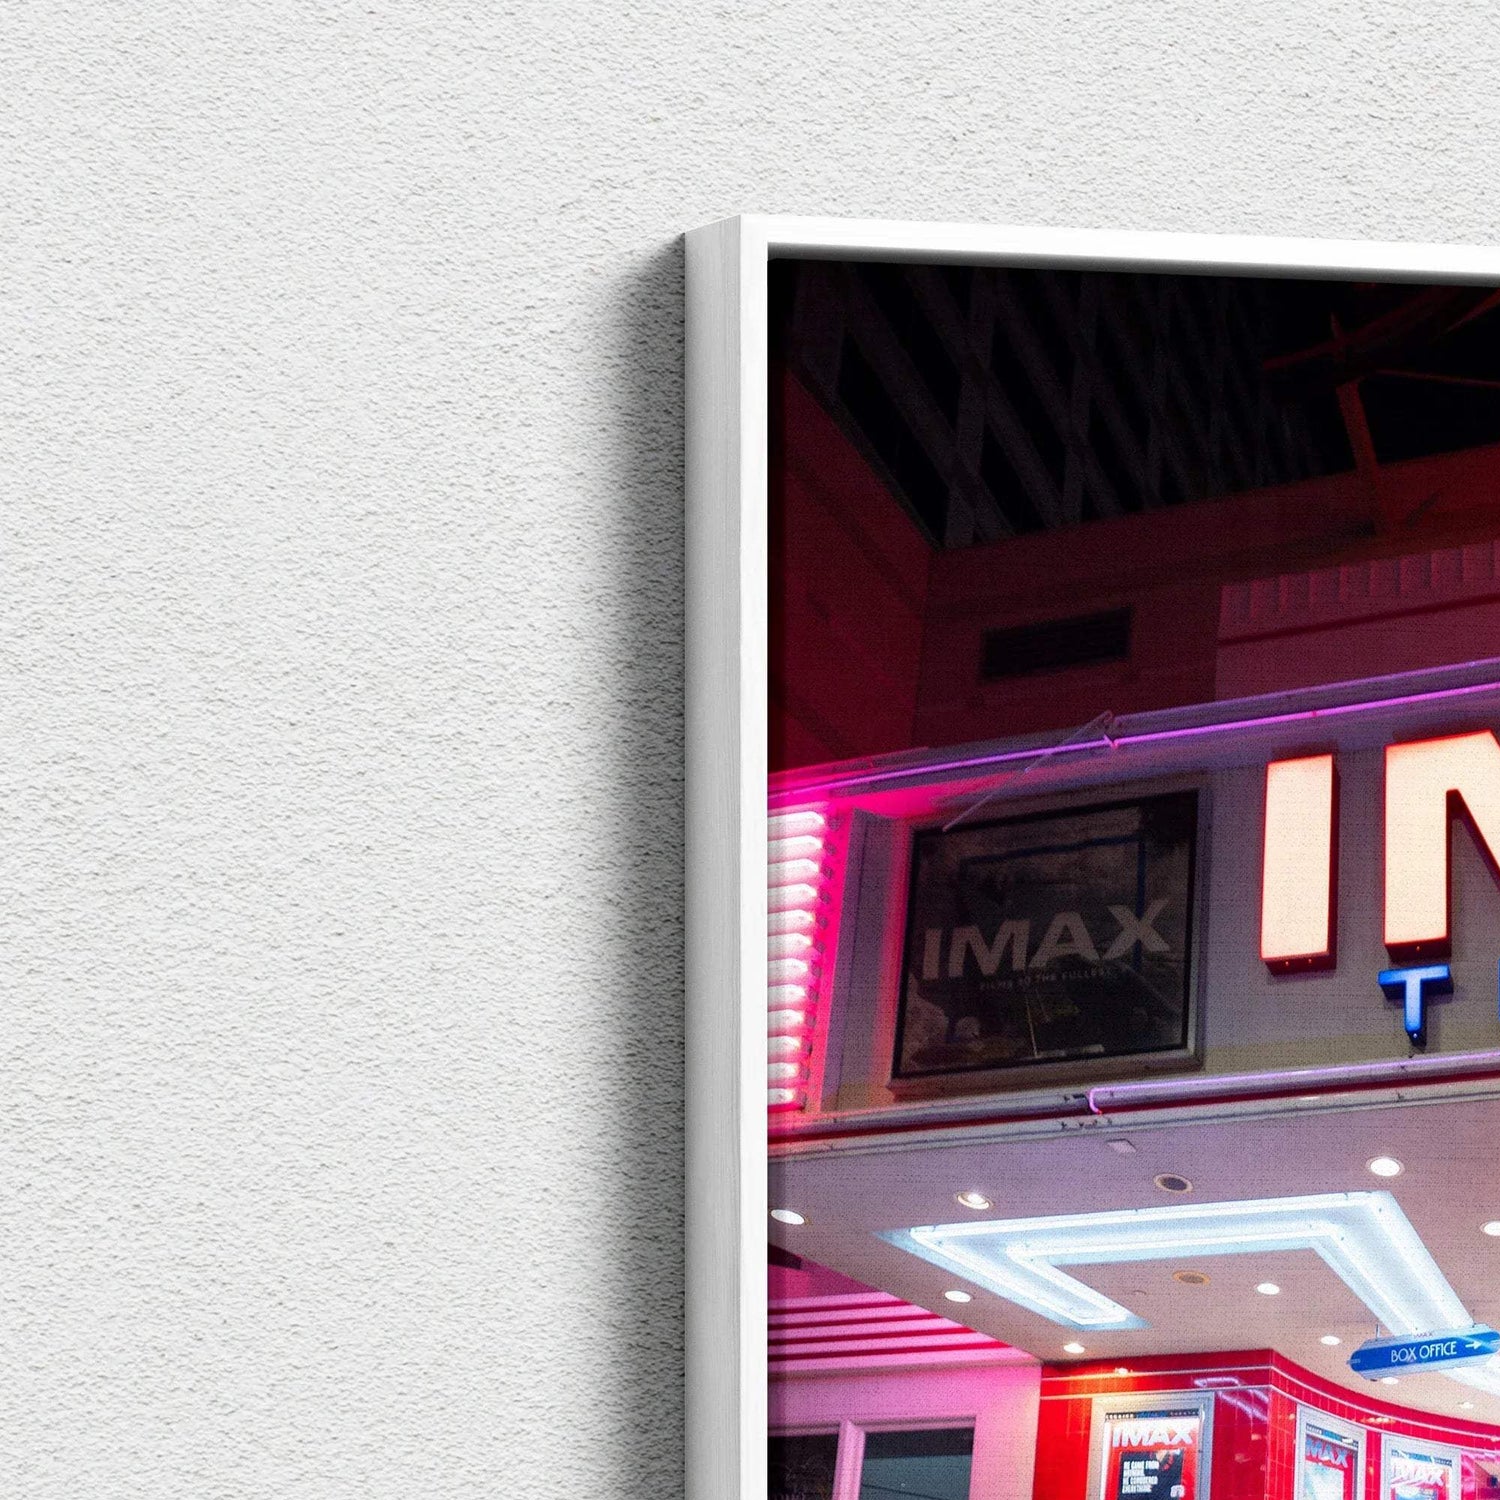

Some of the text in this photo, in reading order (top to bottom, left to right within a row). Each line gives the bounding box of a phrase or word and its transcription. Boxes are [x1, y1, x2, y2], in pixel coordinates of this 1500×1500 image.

[922, 899, 1171, 980] IMAX
[1391, 1341, 1457, 1363] BOX OFFICE
[1112, 1421, 1193, 1448] IMAX
